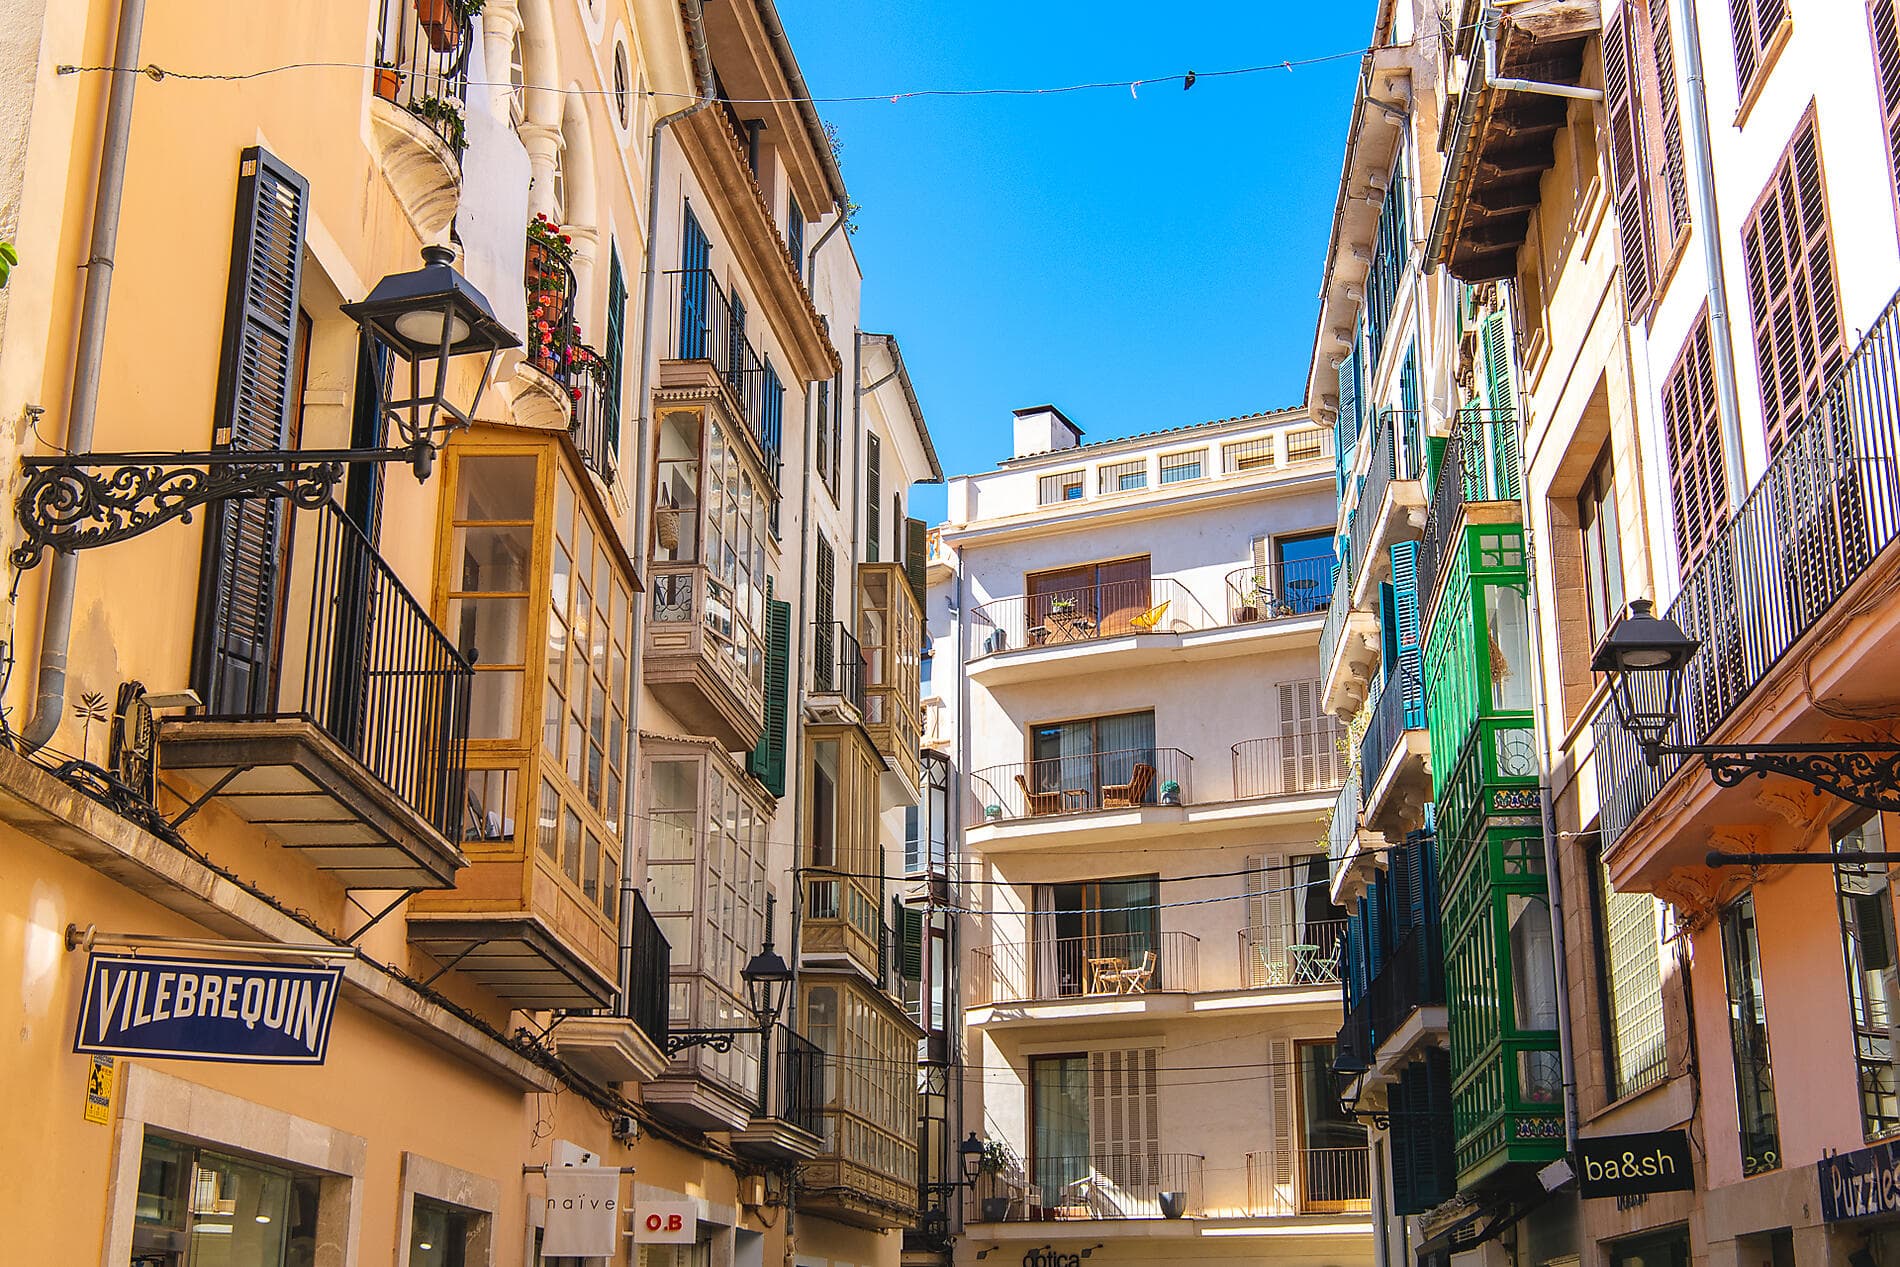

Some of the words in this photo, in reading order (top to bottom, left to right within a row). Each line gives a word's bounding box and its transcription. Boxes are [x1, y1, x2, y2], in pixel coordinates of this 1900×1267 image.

[99, 968, 328, 1052] VILEBREQUIN
[1585, 1149, 1675, 1181] ba&sh
[547, 1193, 615, 1210] naïve
[646, 1214, 682, 1231] O.B
